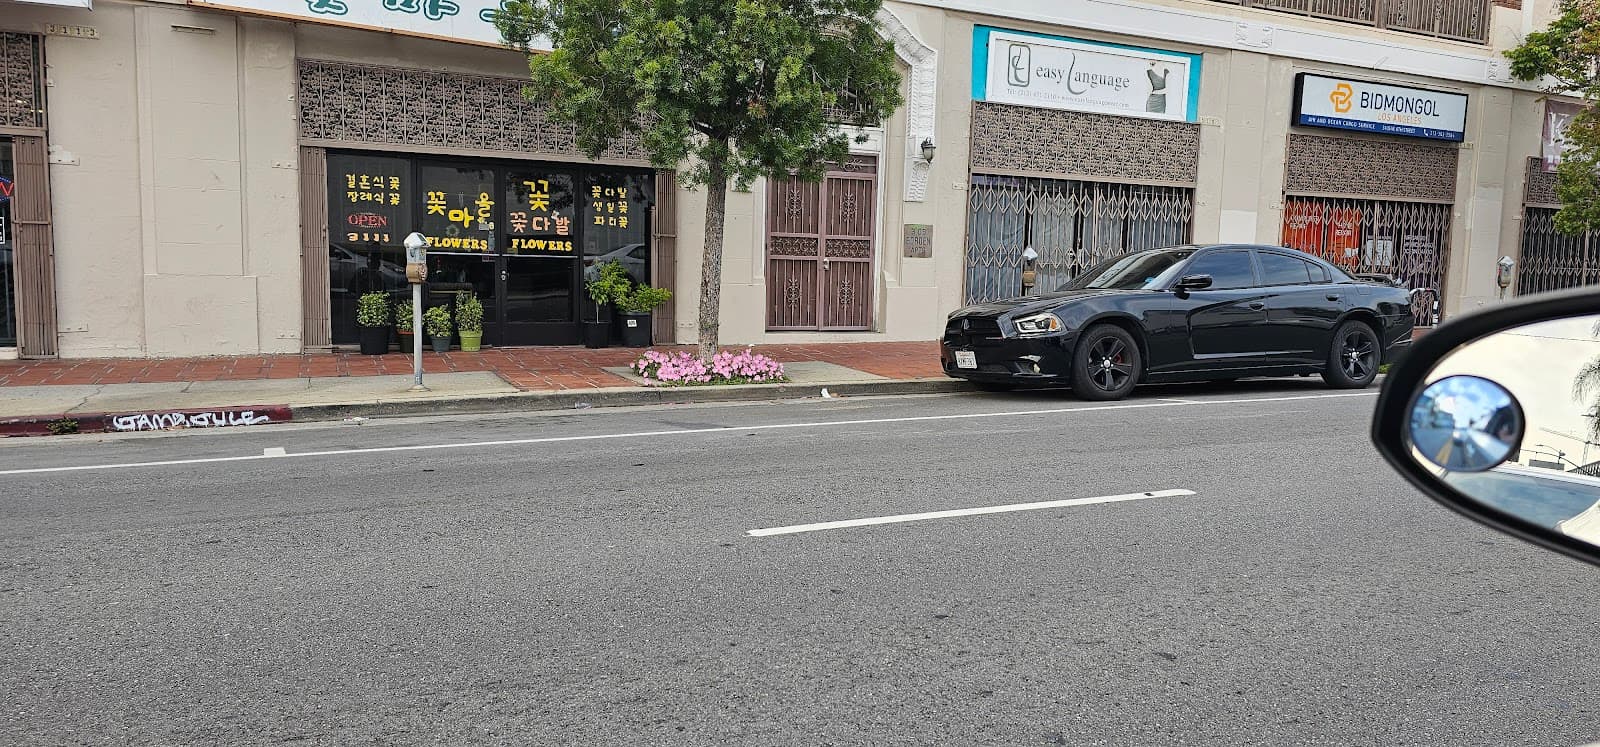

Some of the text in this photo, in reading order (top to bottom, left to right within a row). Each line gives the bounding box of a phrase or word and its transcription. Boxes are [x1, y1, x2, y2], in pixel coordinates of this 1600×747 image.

[1036, 52, 1130, 95] easy Language
[1360, 91, 1440, 117] BIDMONGOL
[1378, 112, 1422, 125] LOS ANGELES
[1358, 122, 1376, 130] SERVICE
[346, 174, 400, 190] 결혼식 꽃
[347, 191, 400, 206] 장례식 꽃
[523, 179, 549, 211] 꽃
[591, 185, 628, 199] 꽃다발
[347, 213, 387, 227] OPEN
[510, 211, 570, 235] 꽃다발
[347, 232, 390, 242] 3111
[427, 236, 488, 250] FLOWERS
[511, 238, 572, 252] FLOWERS
